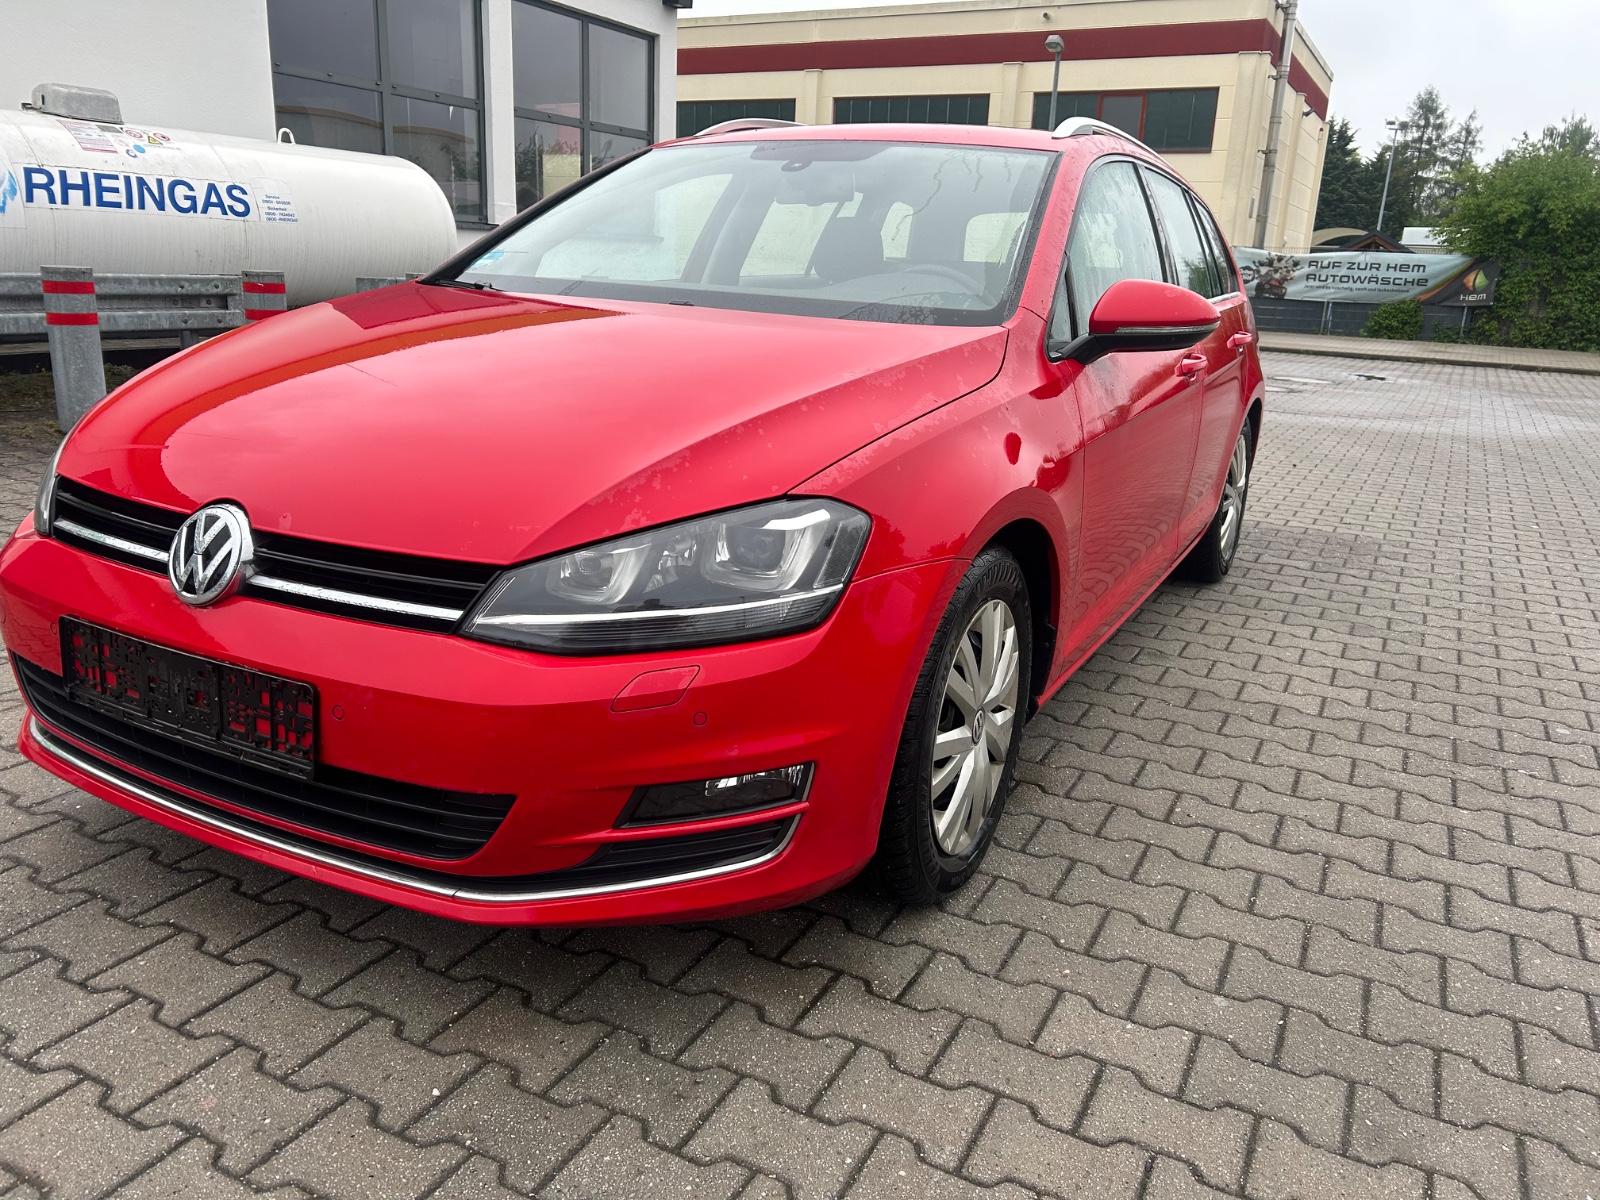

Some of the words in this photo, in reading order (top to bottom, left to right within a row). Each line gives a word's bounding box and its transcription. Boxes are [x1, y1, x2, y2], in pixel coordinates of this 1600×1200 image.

[23, 166, 250, 218] RHEINGAS
[1308, 260, 1342, 269] AUF
[1346, 261, 1381, 272] ZUR
[1305, 273, 1429, 286] AUTOWÄSCHE
